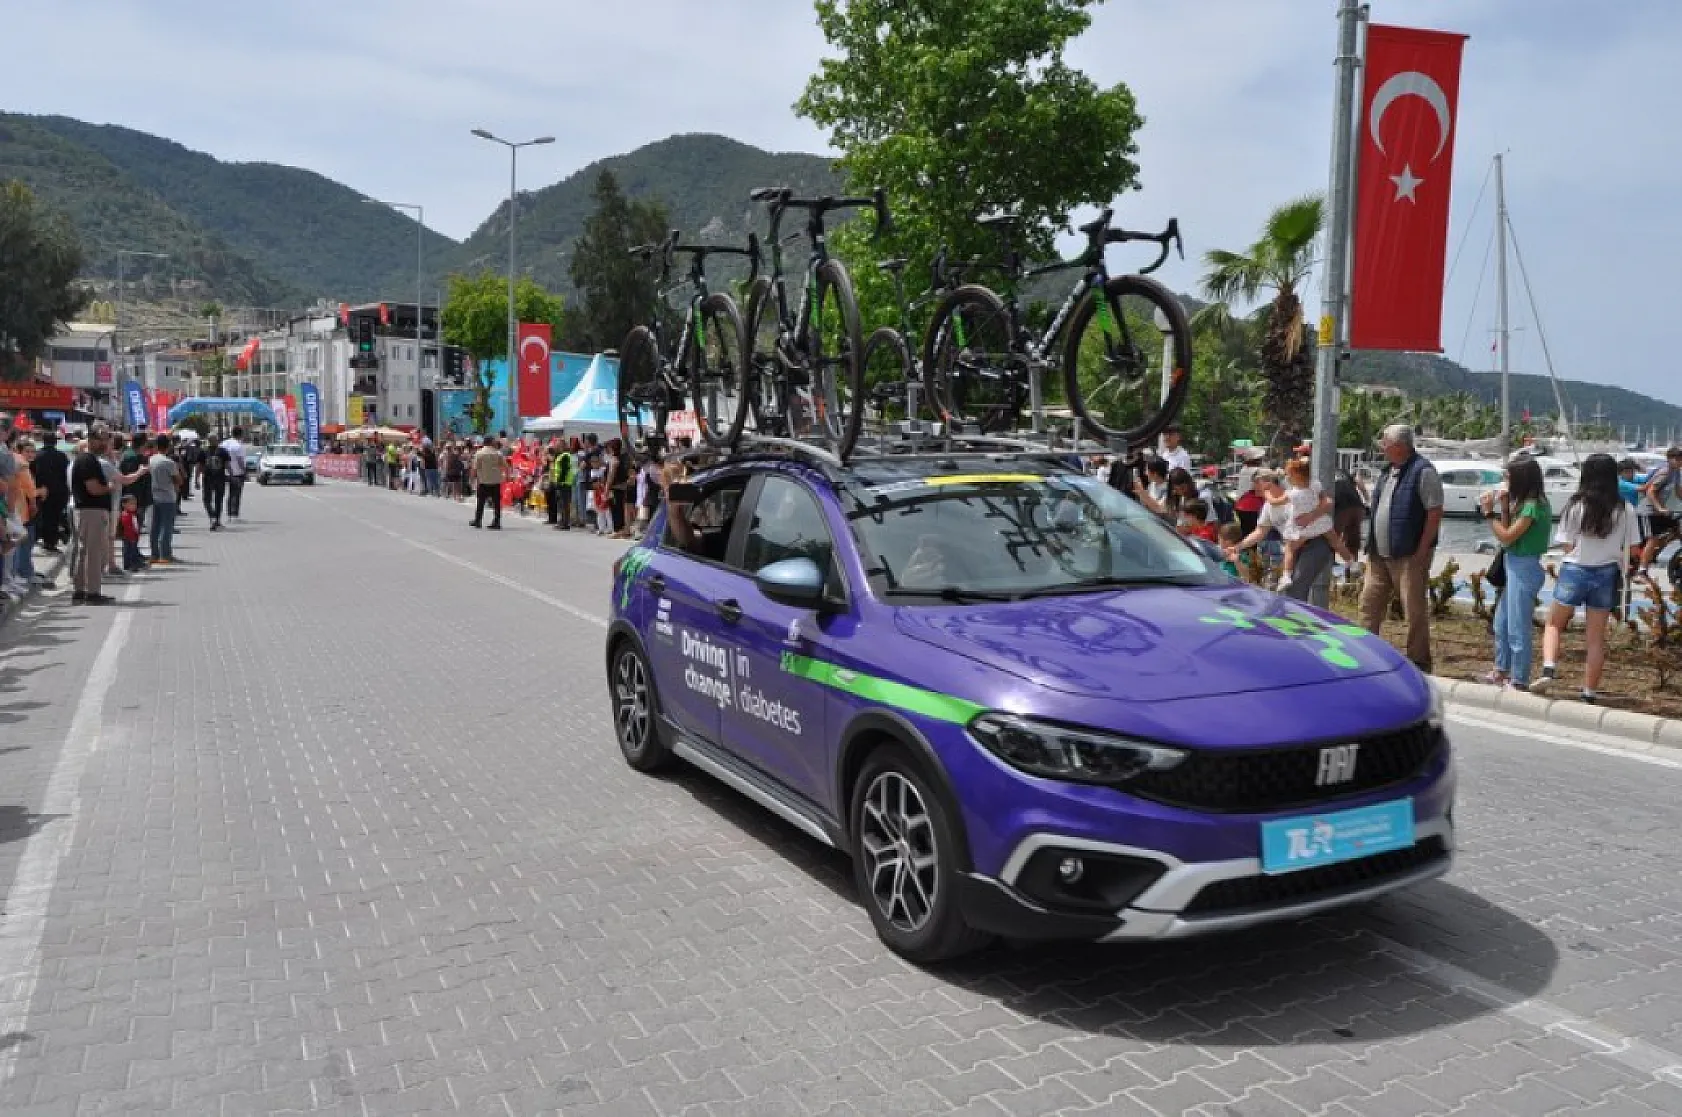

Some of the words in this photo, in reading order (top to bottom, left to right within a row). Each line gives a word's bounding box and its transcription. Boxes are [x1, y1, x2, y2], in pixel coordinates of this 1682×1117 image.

[681, 629, 727, 678] Driving
[736, 647, 750, 678] in
[684, 663, 732, 708] change
[740, 684, 802, 735] diabetes
